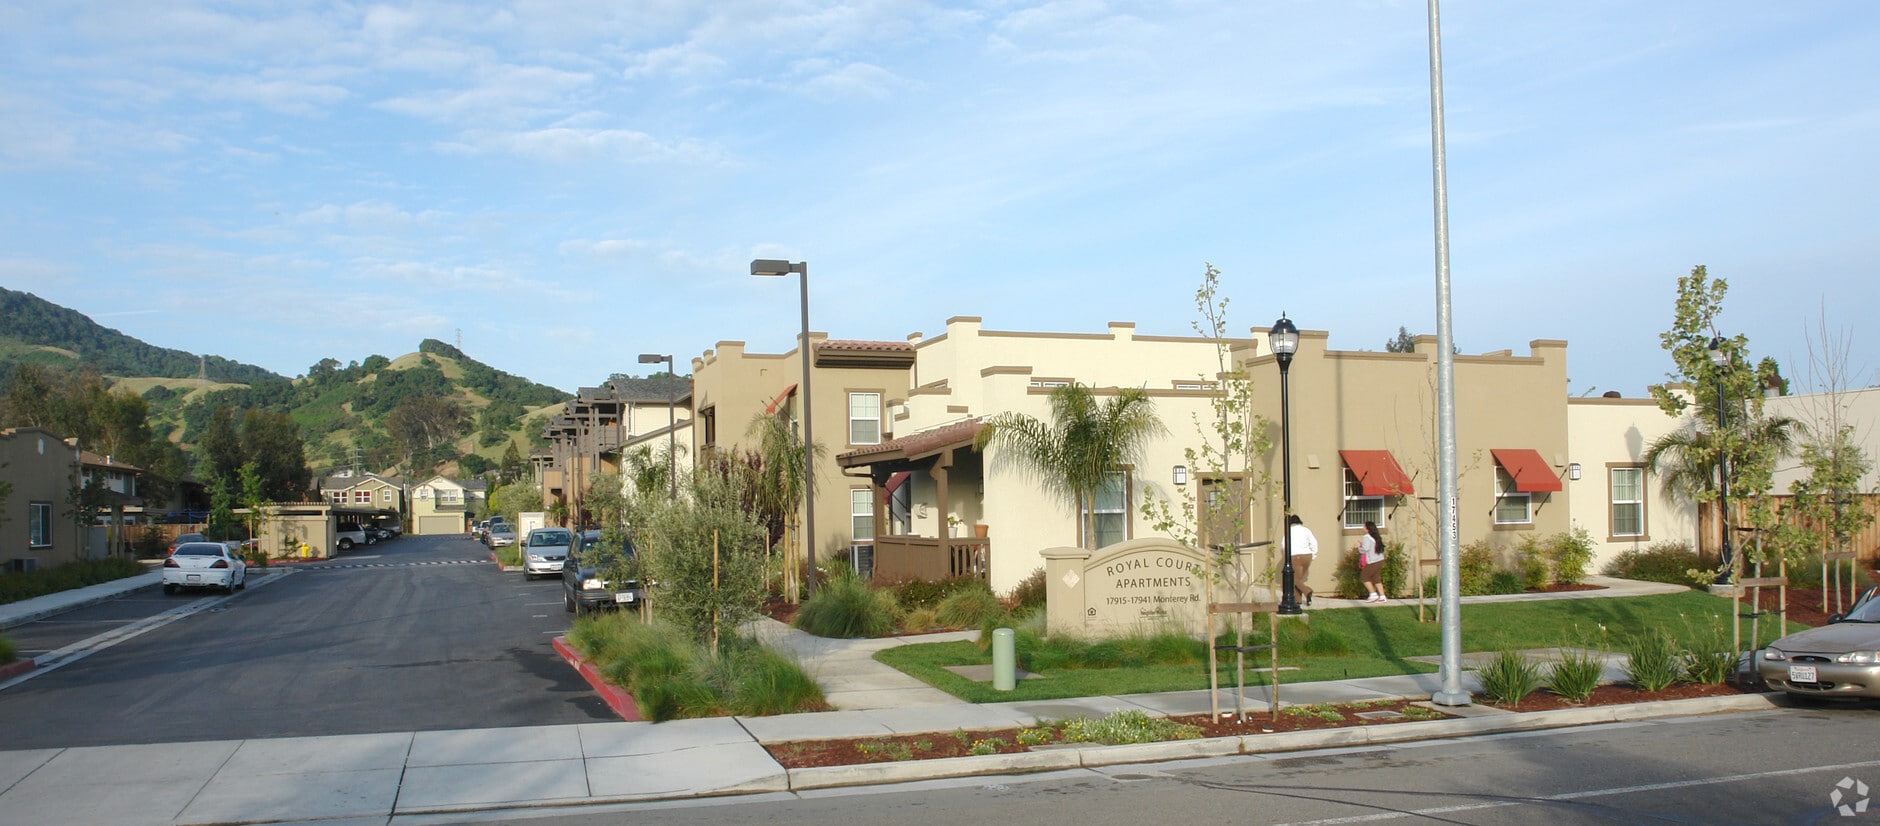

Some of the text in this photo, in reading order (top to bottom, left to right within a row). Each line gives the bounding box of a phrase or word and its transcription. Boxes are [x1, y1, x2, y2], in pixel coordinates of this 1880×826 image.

[1106, 558, 1150, 576] ROYAL
[1115, 576, 1191, 589] APARTMENTS
[1106, 594, 1201, 605] 17915-17941 Monterey Rd.
